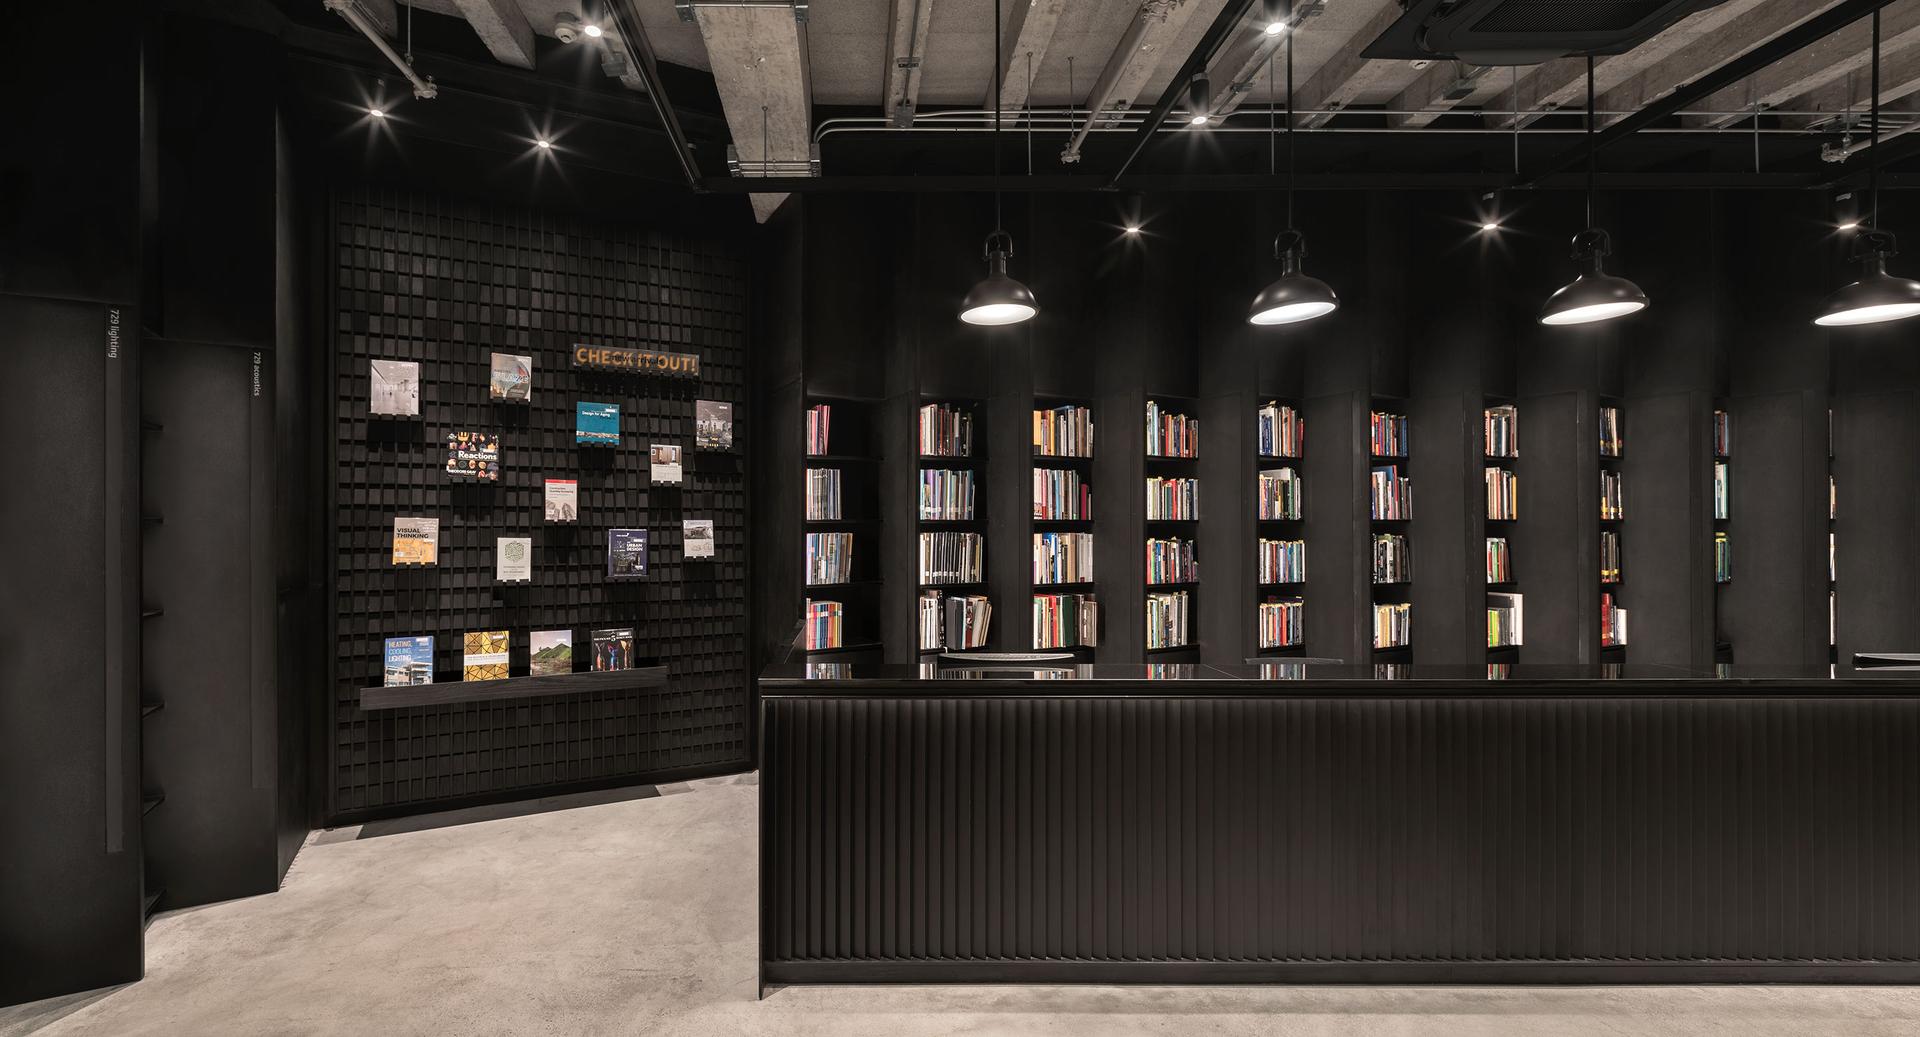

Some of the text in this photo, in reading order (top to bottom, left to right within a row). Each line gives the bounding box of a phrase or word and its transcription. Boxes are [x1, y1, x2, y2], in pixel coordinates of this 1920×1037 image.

[108, 309, 120, 358] 729 lighting
[253, 352, 261, 397] 729 acoustics
[576, 348, 697, 372] CHECK IT OUT!
[458, 450, 497, 460] Reactions
